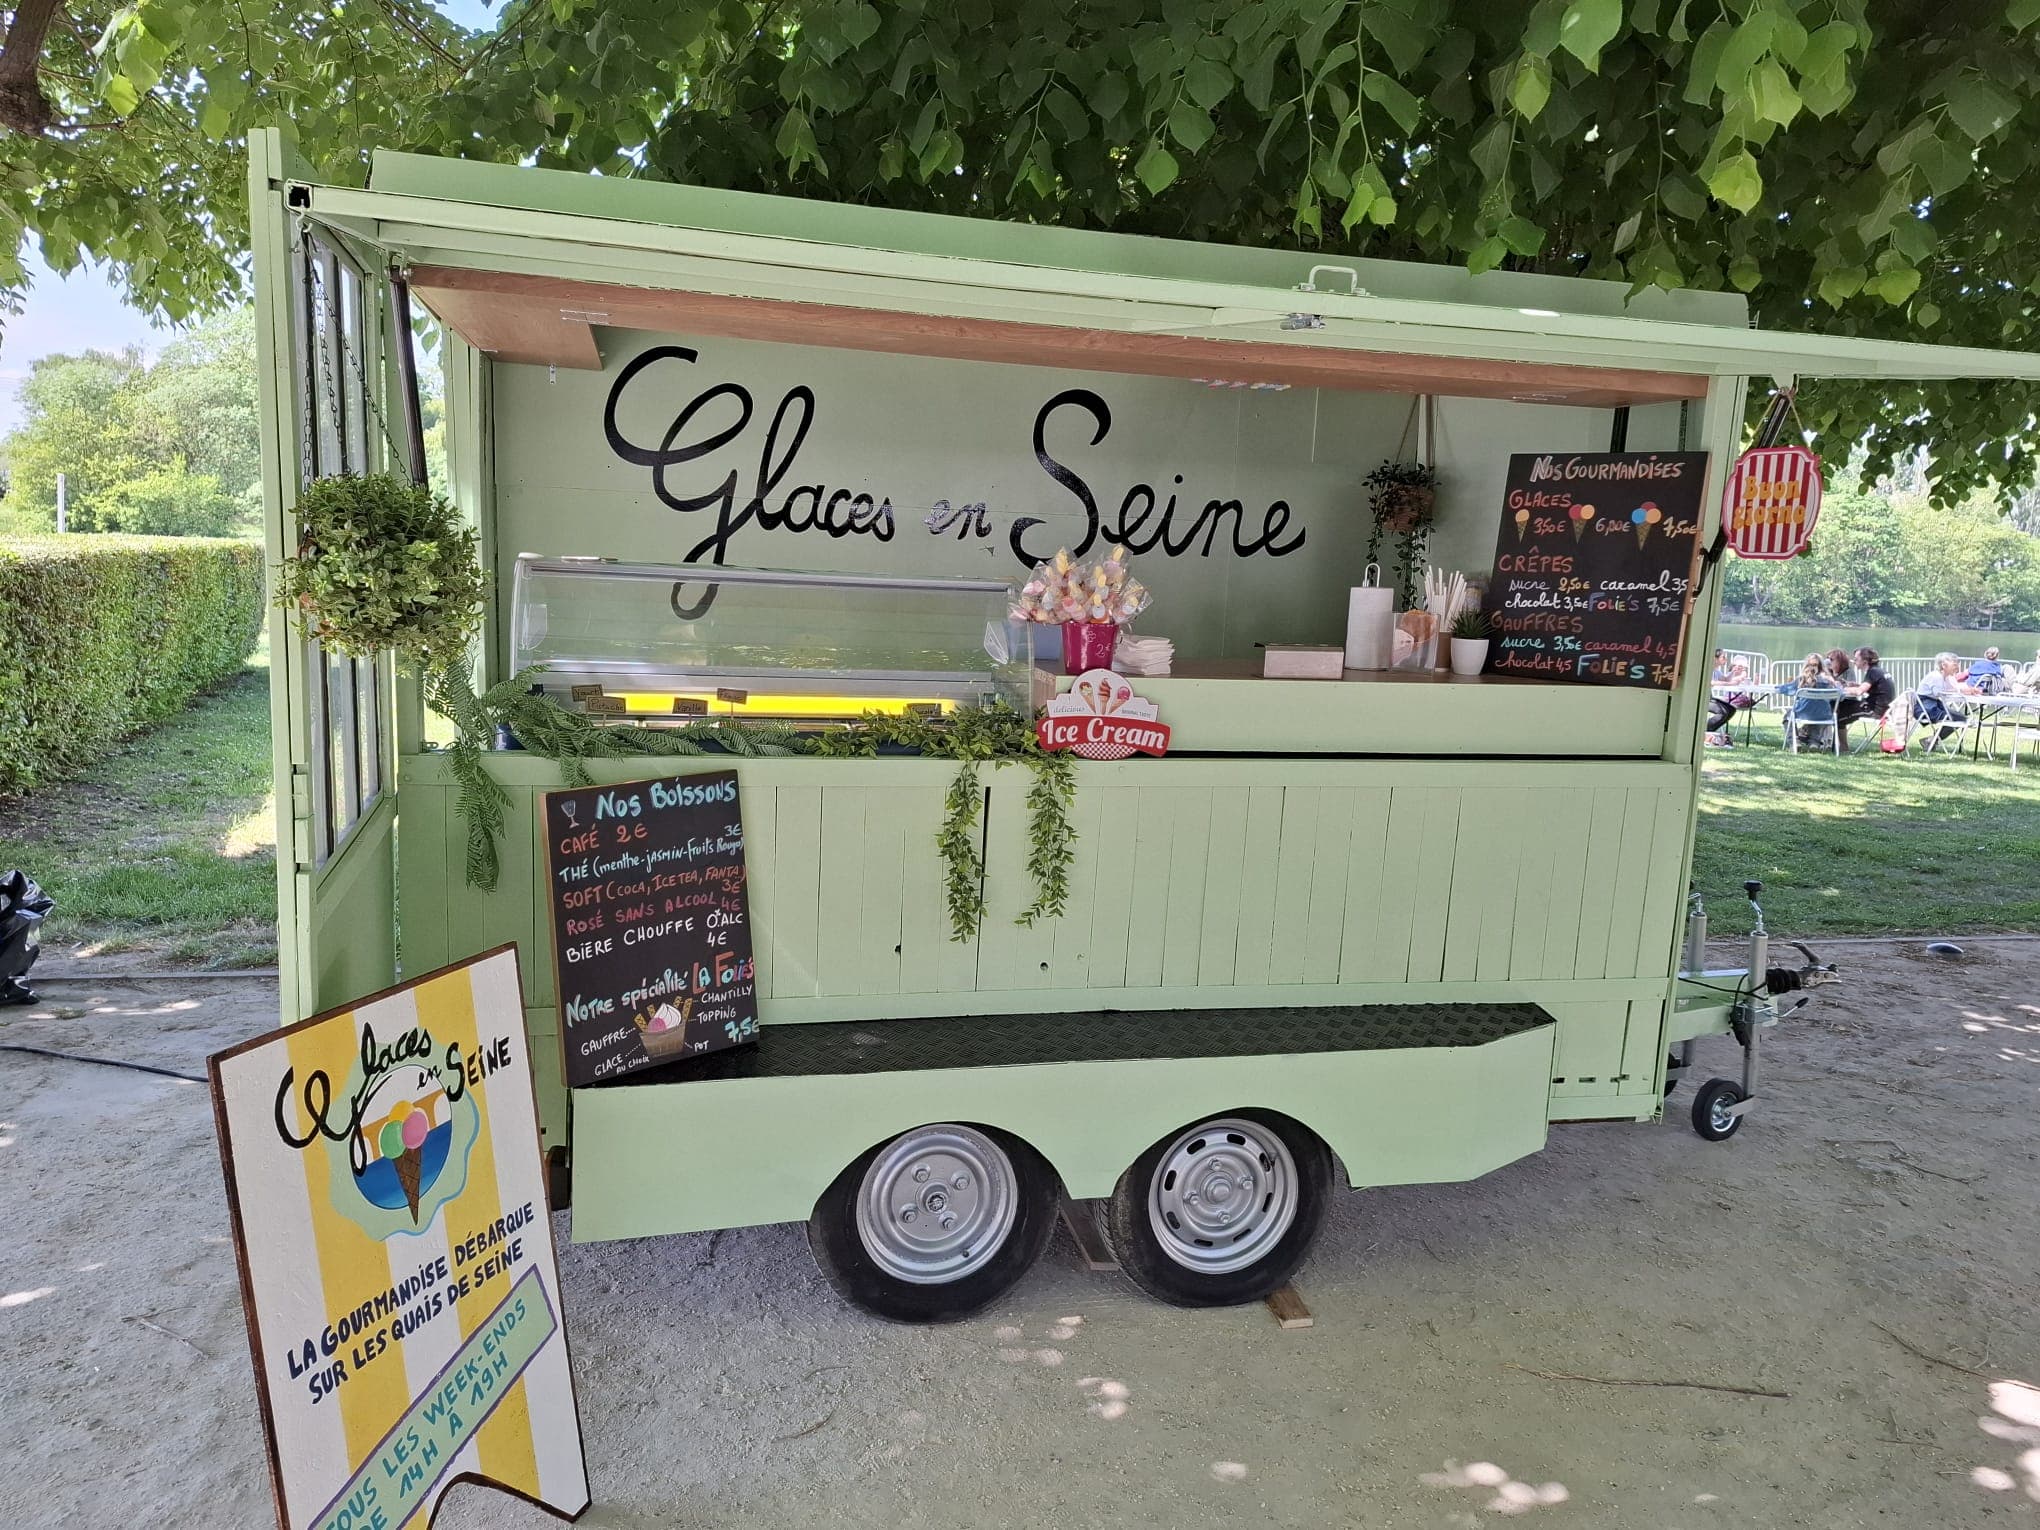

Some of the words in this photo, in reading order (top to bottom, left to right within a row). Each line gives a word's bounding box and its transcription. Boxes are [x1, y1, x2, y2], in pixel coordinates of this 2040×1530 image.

[602, 344, 896, 620] Glaces
[924, 498, 992, 541] en
[1009, 387, 1307, 570] Seine
[1529, 455, 1563, 483] Nos
[1509, 489, 1572, 509] GLACES
[1743, 474, 1800, 501] Buon
[1533, 516, 1566, 536] 3,50€
[1733, 501, 1806, 531] giorno
[1499, 545, 1574, 574] CRÊPES
[1508, 579, 1550, 592] sucre
[1558, 576, 1591, 594] 2,50€
[1600, 569, 1671, 592] caramel
[1505, 591, 1561, 609] chocolat
[1647, 596, 1680, 617] 7,5€
[1491, 609, 1584, 634] GAUFFRES
[1501, 635, 1545, 649] sucre
[1584, 635, 1651, 654] caramel
[1495, 649, 1554, 670] chocolat
[1042, 719, 1079, 745] Ice
[1087, 718, 1165, 749] Cream
[560, 823, 600, 854] CAFÉ
[724, 823, 742, 837] 3€
[559, 857, 589, 883] THÉ
[563, 884, 603, 910] SOFT
[721, 879, 741, 893] 3€
[566, 908, 605, 936] ROSÉ
[615, 902, 656, 923] SANS
[664, 891, 718, 914] ALCOOL
[721, 896, 741, 912] 4€
[623, 916, 695, 946] CHOUFFE
[692, 961, 712, 994] LA
[701, 984, 753, 1003] CHANTILLY
[697, 1005, 737, 1024] TOPPING
[724, 1015, 760, 1043] 7,5€
[694, 1039, 709, 1052] POT
[594, 1053, 624, 1076] GLACE
[616, 1065, 626, 1075] AU
[275, 1022, 432, 1177] Glaces
[417, 1065, 442, 1090] en
[445, 1036, 512, 1102] SEINE
[287, 1338, 318, 1379] LA
[320, 1255, 449, 1357] GOURMANDISE
[454, 1201, 536, 1267] DÉBARQUE
[308, 1359, 348, 1404] SUR
[352, 1328, 388, 1370] LES
[391, 1294, 443, 1341] QUAIS
[446, 1275, 471, 1306] DE
[474, 1238, 524, 1288] SEINE
[382, 1424, 420, 1478] LES
[422, 1298, 527, 1426] WEEK-ENDS
[399, 1438, 440, 1499] 14H
[470, 1350, 509, 1406] 19H
